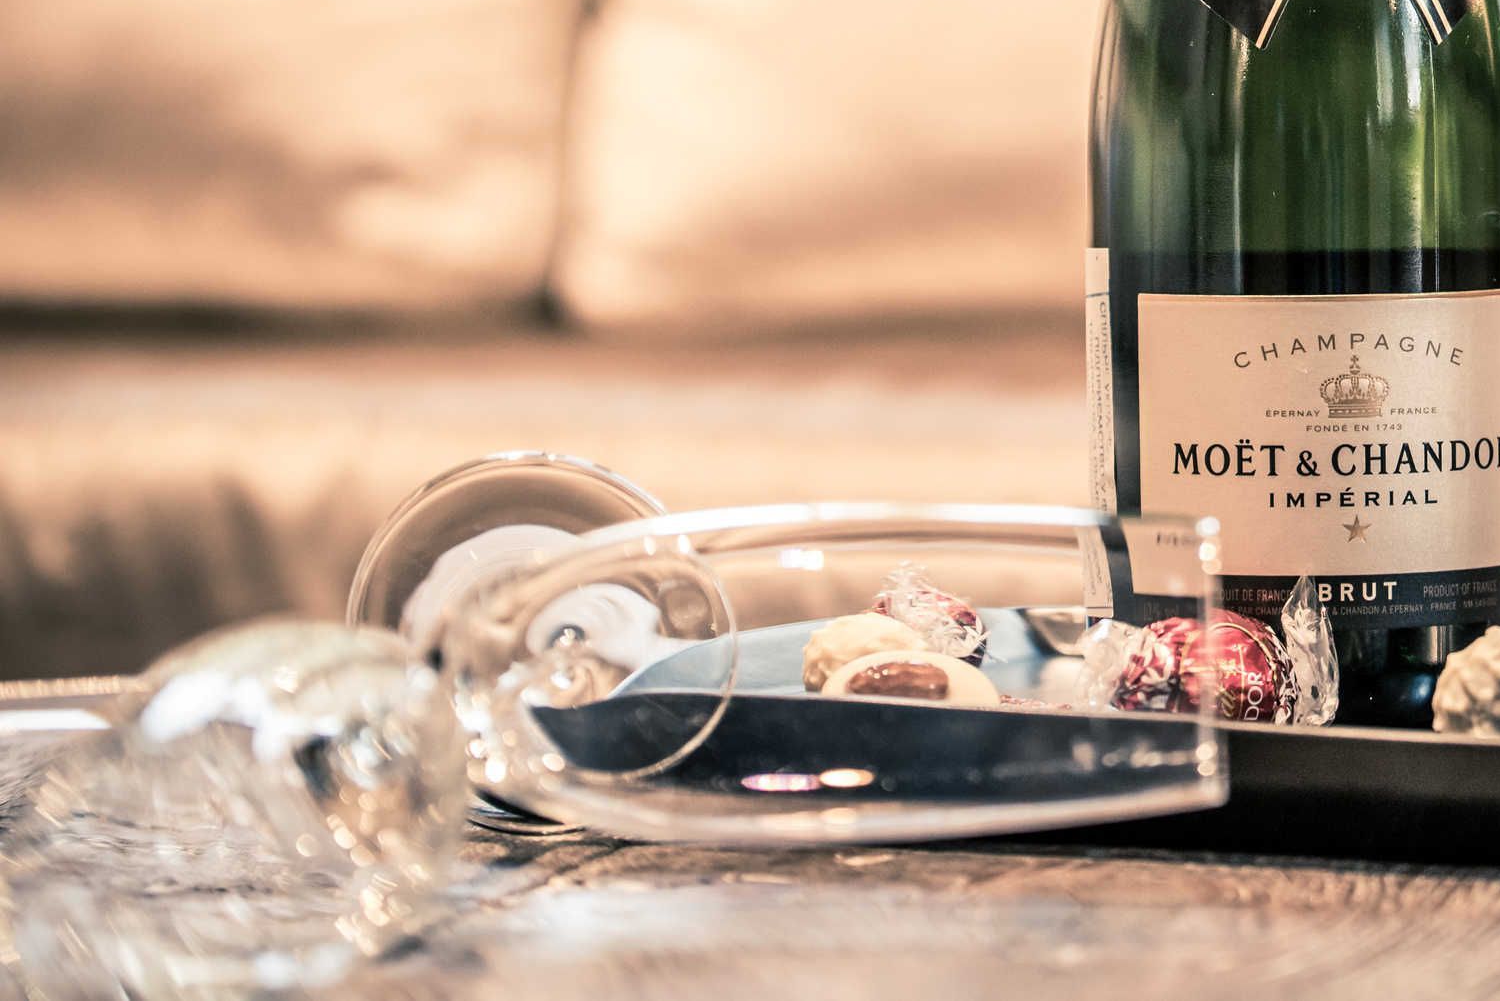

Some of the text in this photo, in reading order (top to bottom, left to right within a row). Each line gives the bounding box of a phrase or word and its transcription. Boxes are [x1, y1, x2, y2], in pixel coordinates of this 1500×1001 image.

[1233, 332, 1465, 370] CHAMPAGNE
[1390, 406, 1439, 416] FRANCE
[1354, 424, 1370, 432] EN
[1376, 422, 1403, 431] 1743
[1172, 438, 1287, 477] MOËT
[1296, 449, 1321, 477] &
[1268, 487, 1440, 509] IMPÉRIAL
[1241, 589, 1254, 602] DE
[1317, 581, 1398, 603] BRUT
[1423, 584, 1460, 598] PRODUCT
[1461, 582, 1472, 594] OF
[1340, 605, 1380, 617] CHANDON
[1430, 600, 1457, 611] FRANCE
[1243, 671, 1265, 721] DOR
